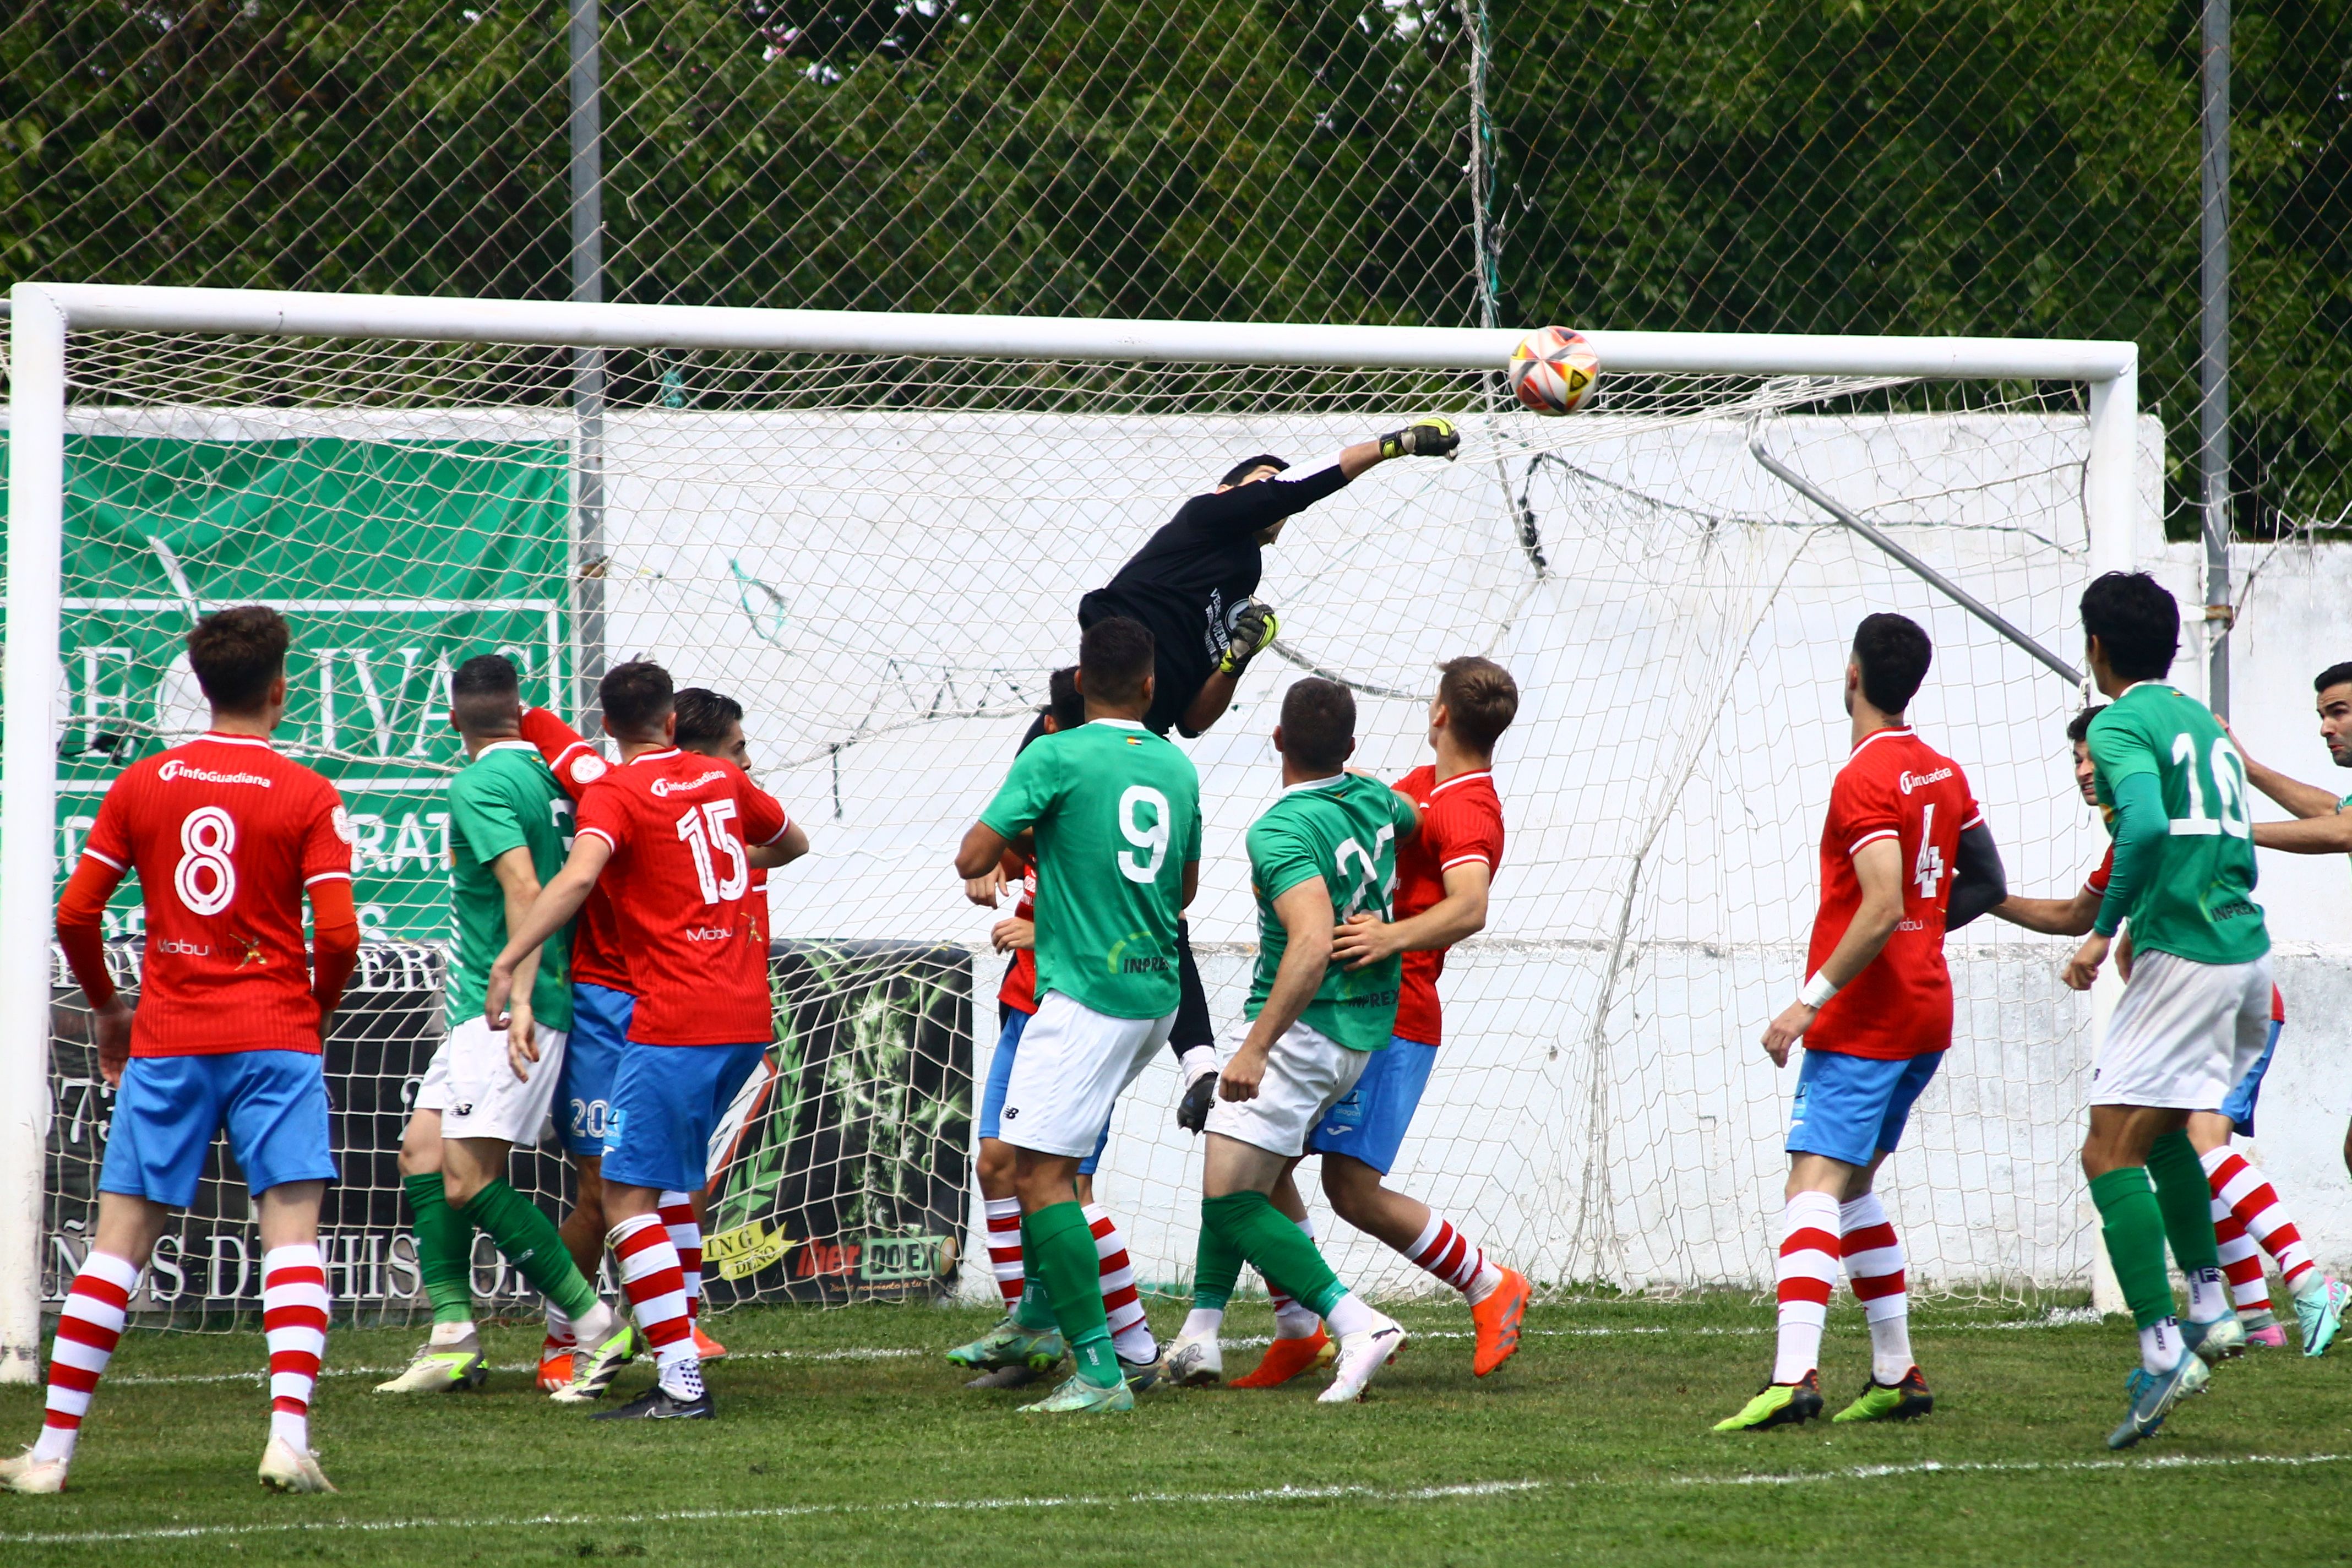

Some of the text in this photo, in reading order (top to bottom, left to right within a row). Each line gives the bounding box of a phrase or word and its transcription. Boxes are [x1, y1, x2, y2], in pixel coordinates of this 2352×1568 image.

[179, 765, 271, 789] InfoGuadiana
[666, 770, 727, 791] InfoGuadiana
[2169, 733, 2251, 839] 10
[174, 806, 236, 916] 8
[676, 798, 749, 905] 15
[1118, 786, 1170, 884] 9
[1913, 803, 1944, 899] 4
[157, 938, 209, 956] Mobu
[686, 925, 733, 942] Mobu
[570, 1098, 608, 1138] 20
